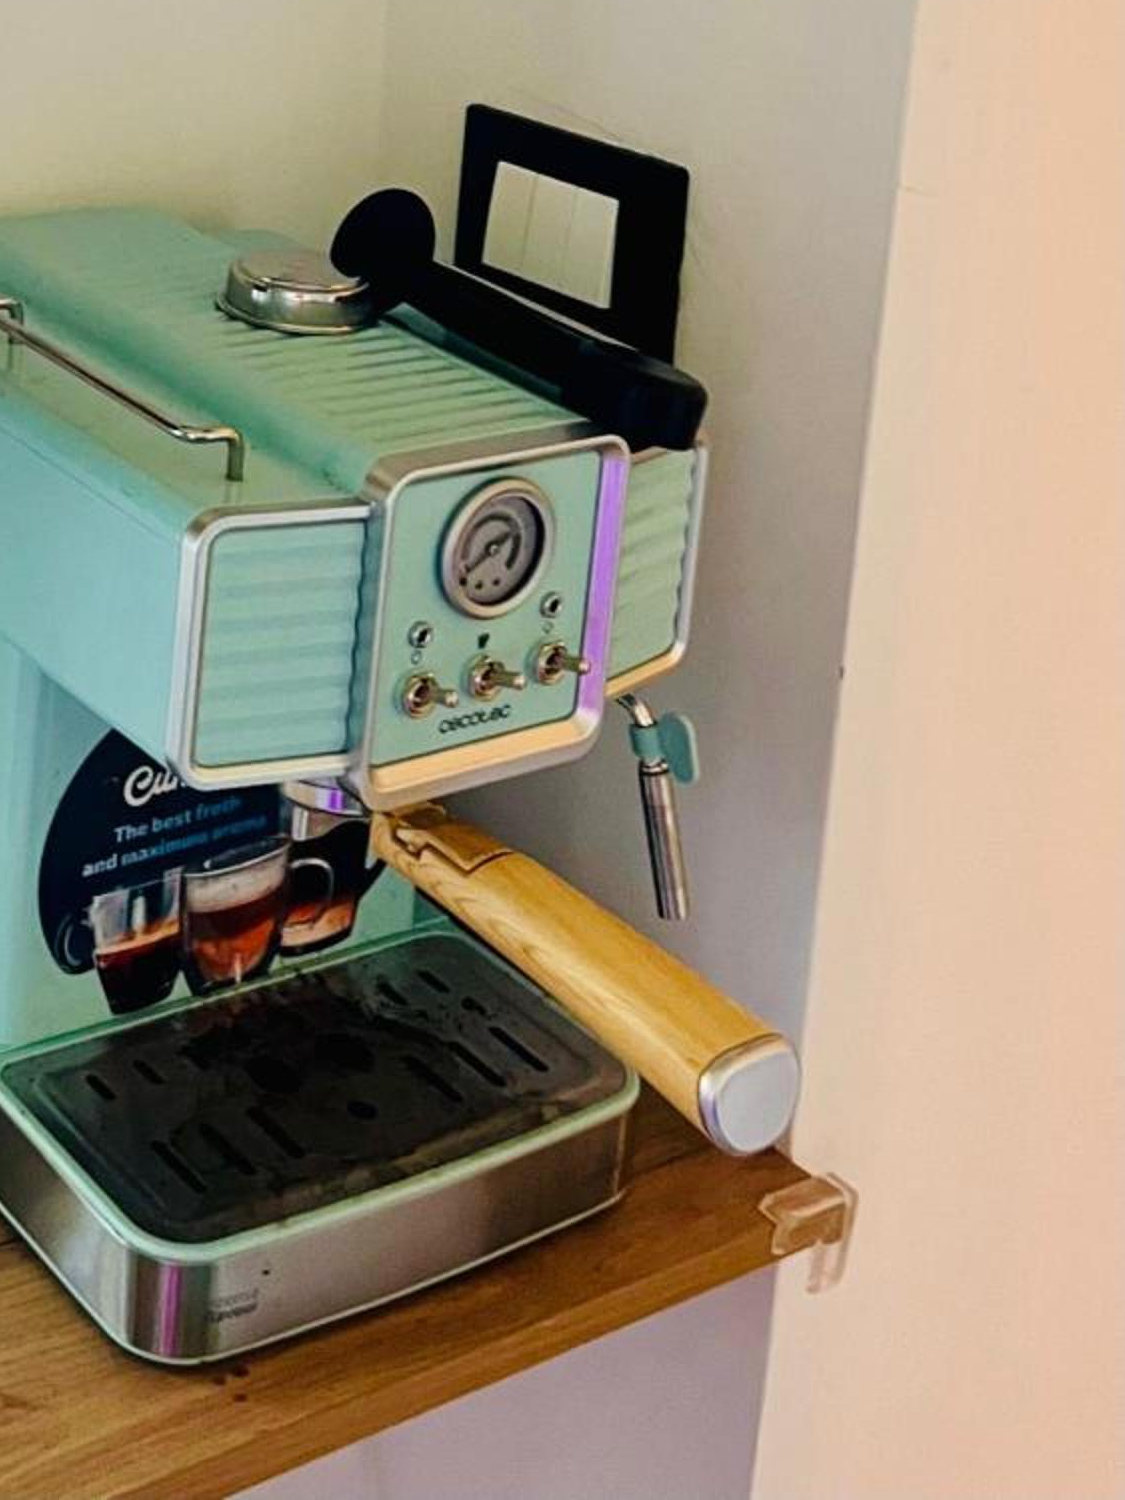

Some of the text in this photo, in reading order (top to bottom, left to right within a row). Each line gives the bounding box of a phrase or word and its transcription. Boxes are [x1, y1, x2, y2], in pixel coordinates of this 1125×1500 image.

[114, 822, 149, 843] The
[152, 809, 193, 833] best
[81, 852, 119, 878] and
[121, 830, 209, 867] maximum
